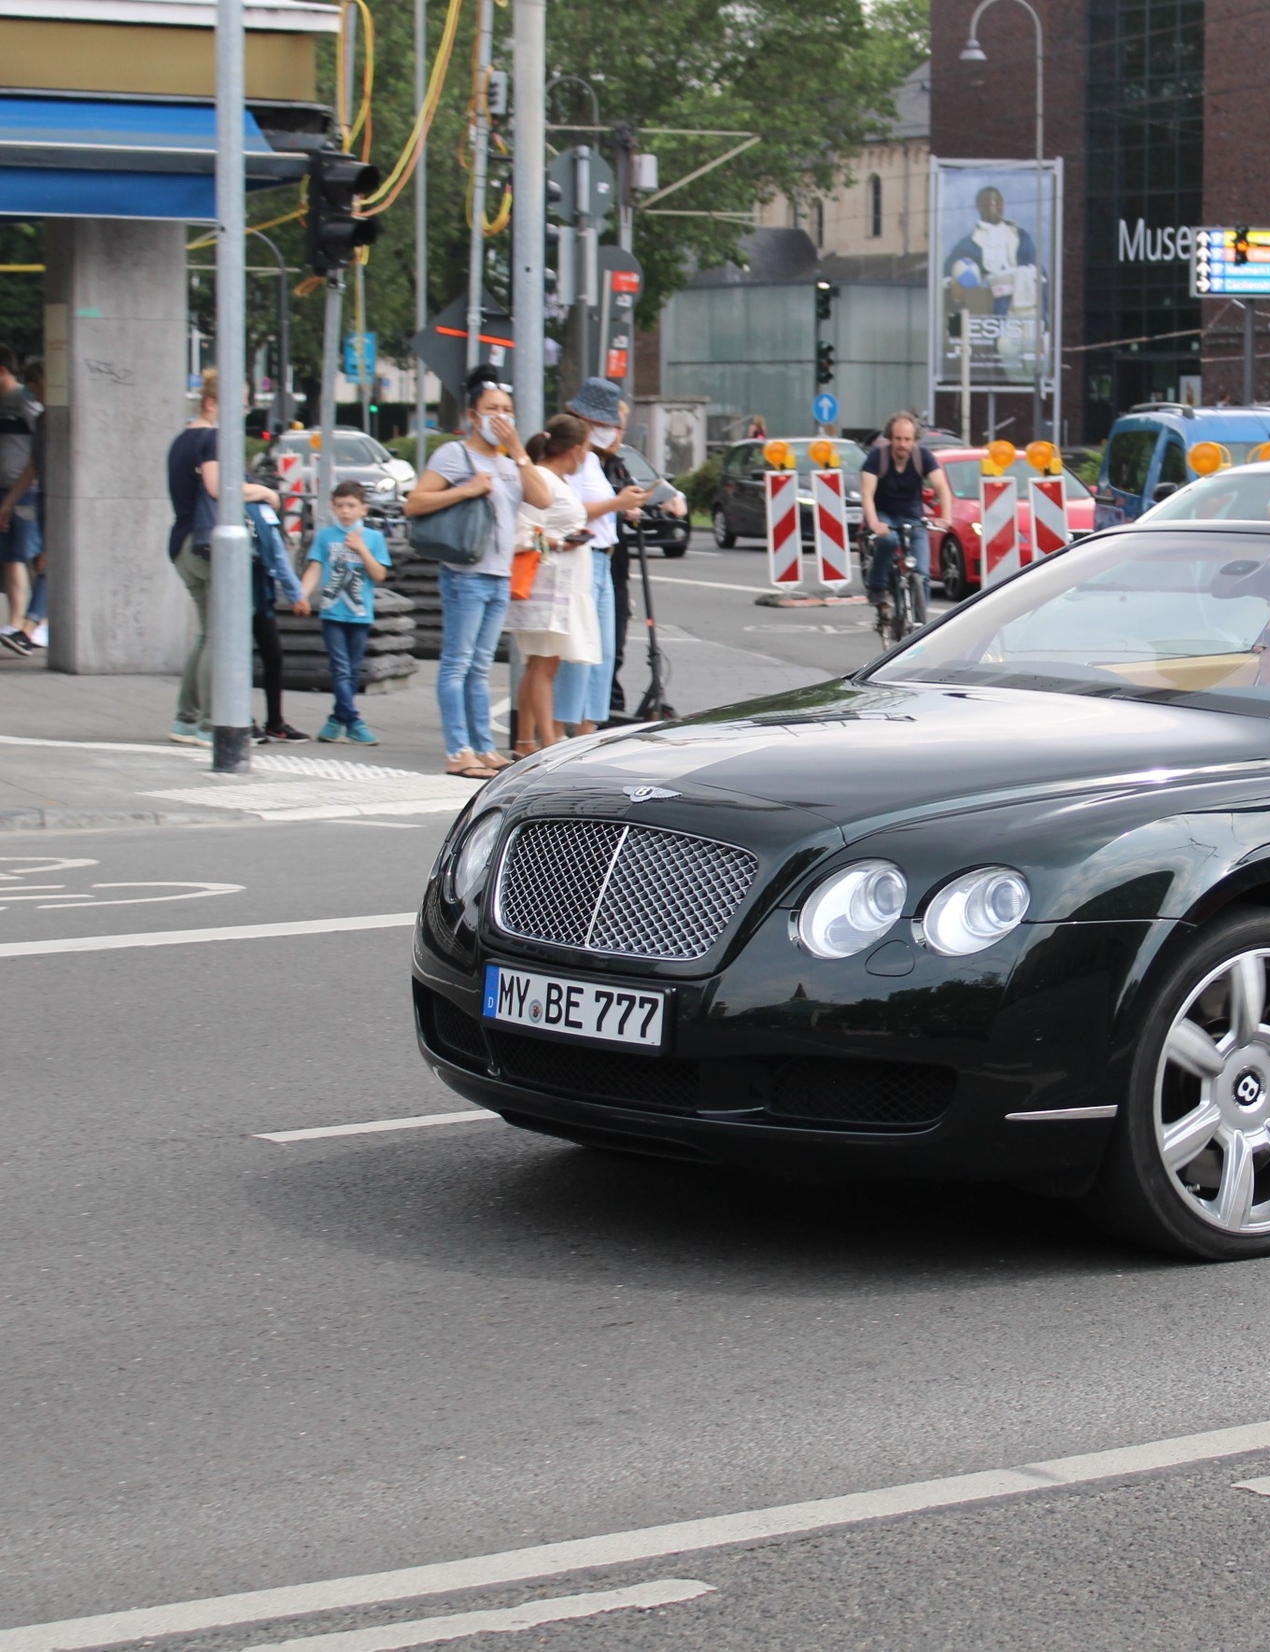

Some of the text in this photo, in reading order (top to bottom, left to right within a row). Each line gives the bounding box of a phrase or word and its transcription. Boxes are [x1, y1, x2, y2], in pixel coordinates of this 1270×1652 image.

[498, 972, 531, 1018] MY
[544, 982, 584, 1029] BE
[594, 989, 660, 1039] 777
